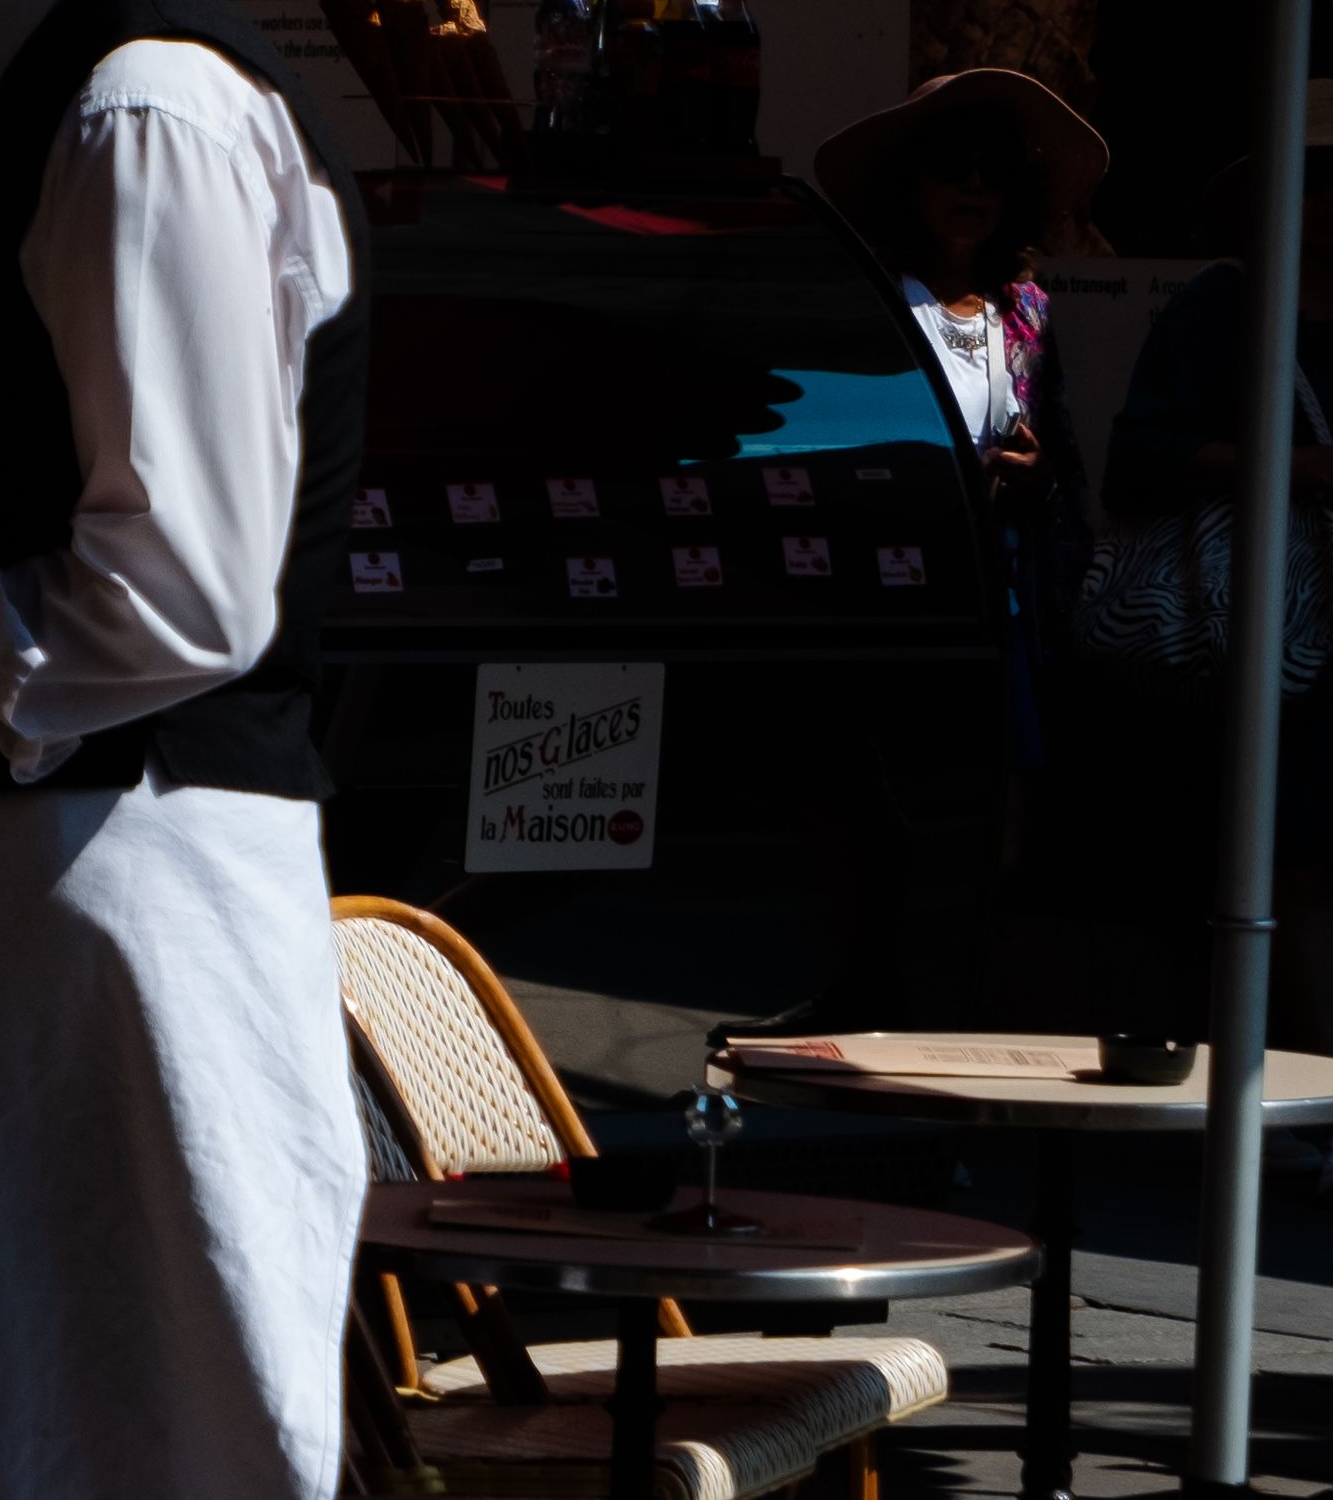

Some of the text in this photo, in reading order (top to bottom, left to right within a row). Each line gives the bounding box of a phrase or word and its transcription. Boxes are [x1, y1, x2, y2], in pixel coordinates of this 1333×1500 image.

[260, 12, 323, 31] workers use
[303, 38, 342, 64] damag
[1051, 274, 1068, 293] du
[1069, 276, 1128, 300] transept
[487, 690, 555, 724] Toutes
[483, 702, 641, 790] nos Glaces
[542, 776, 646, 802] sont faites par
[480, 814, 496, 841] la
[499, 803, 606, 844] Maison
